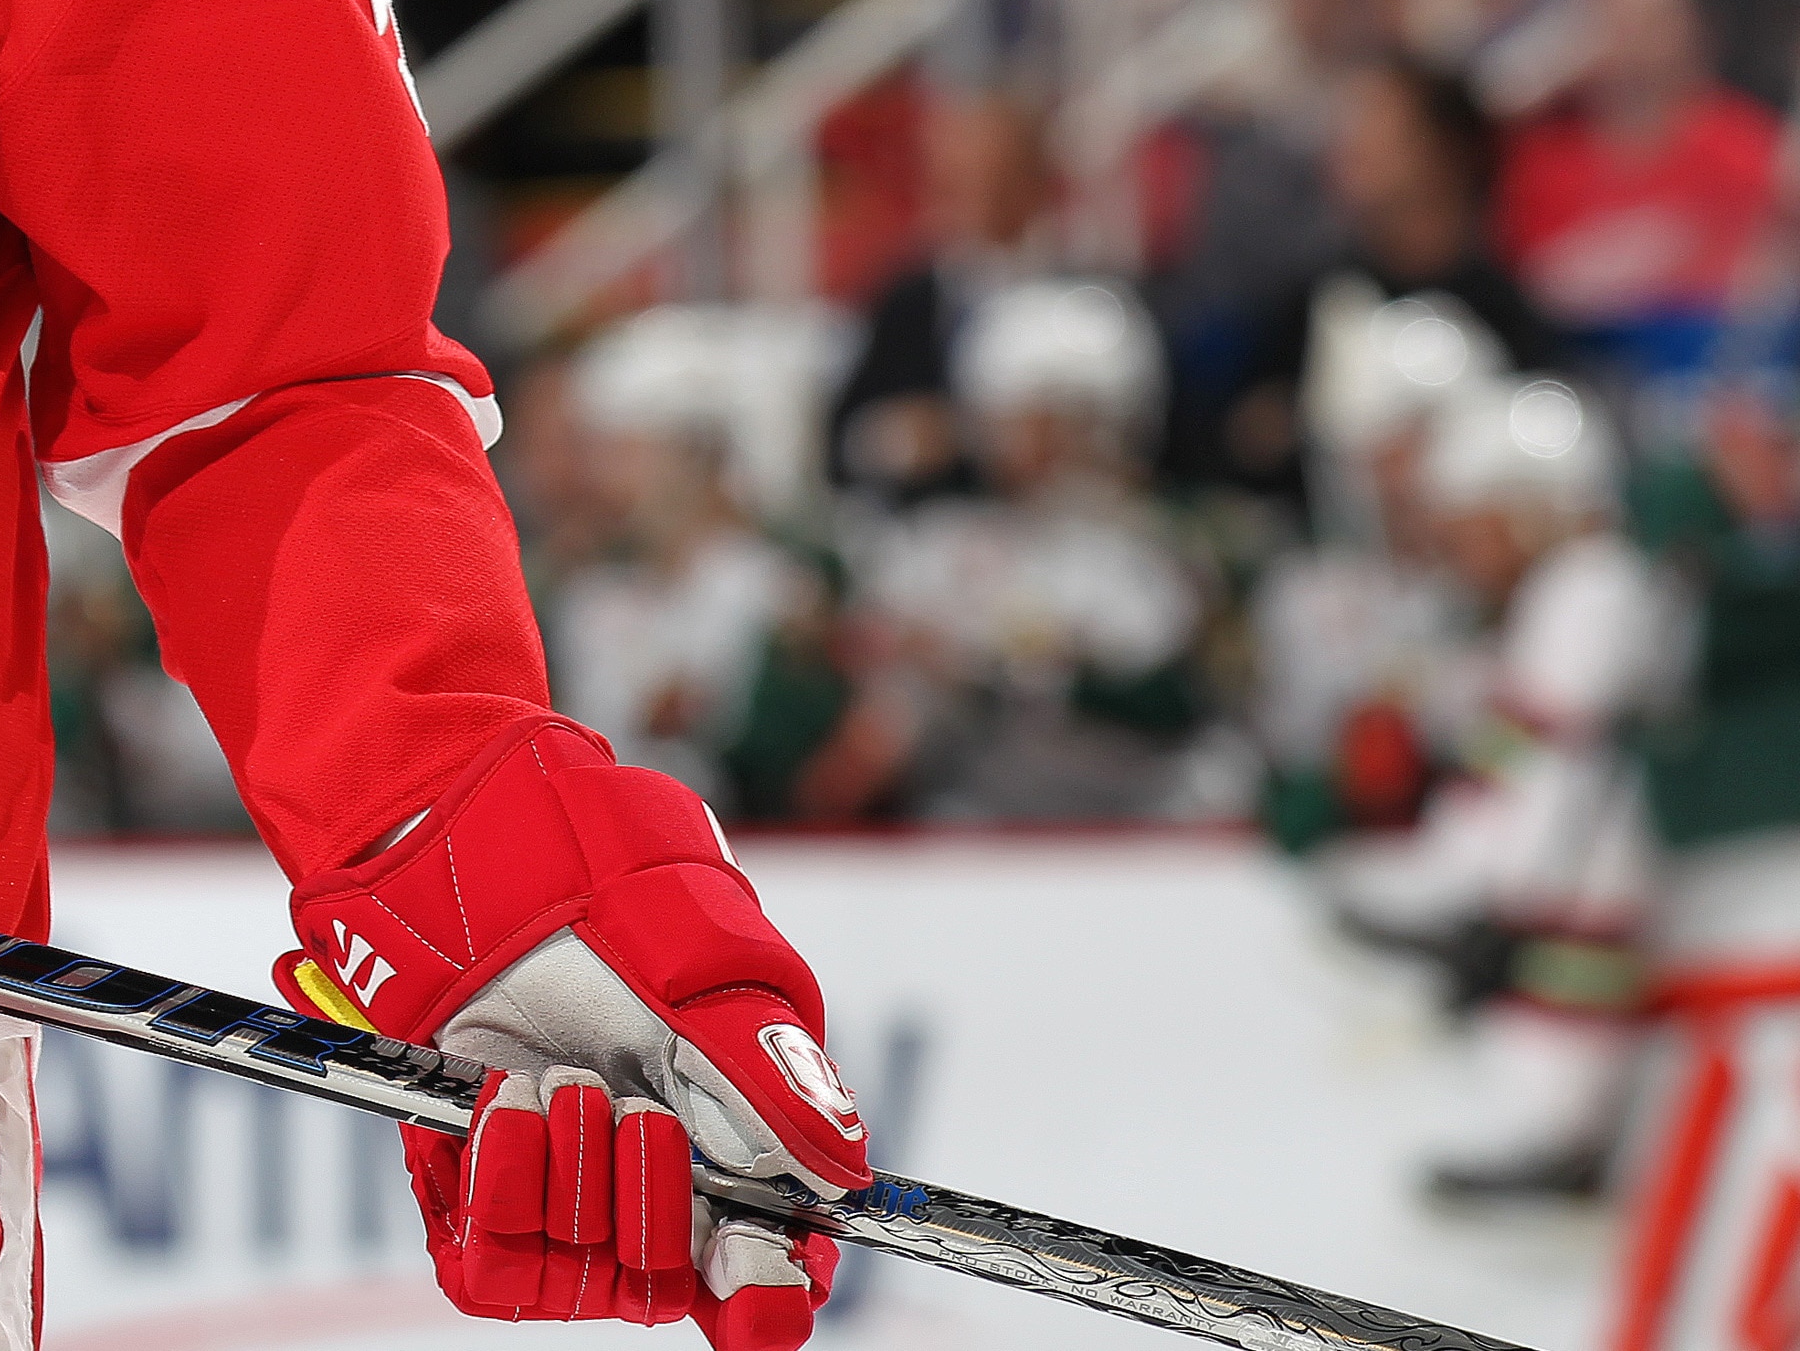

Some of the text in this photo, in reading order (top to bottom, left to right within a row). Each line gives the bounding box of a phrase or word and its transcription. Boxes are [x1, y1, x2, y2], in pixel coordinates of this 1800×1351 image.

[938, 1248, 979, 1267] PRO
[1070, 1284, 1099, 1300] NO
[1109, 1293, 1218, 1331] WARRANTY
